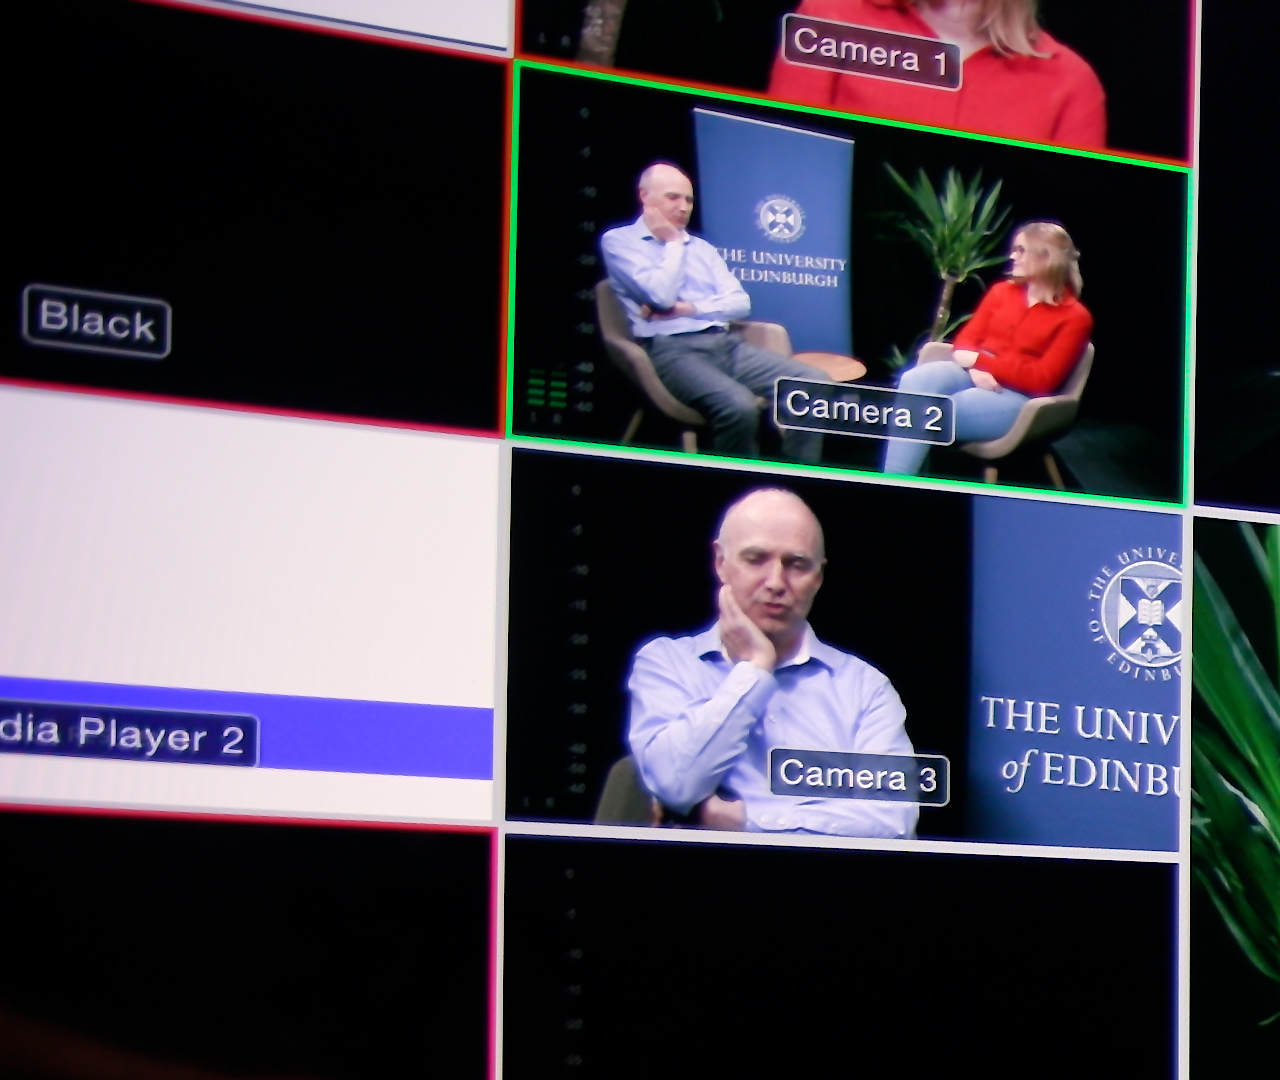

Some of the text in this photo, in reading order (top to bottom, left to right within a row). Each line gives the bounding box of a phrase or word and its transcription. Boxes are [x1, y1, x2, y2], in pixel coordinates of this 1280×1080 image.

[794, 27, 946, 76] Camera 1
[740, 268, 838, 288] EDINBURGH
[752, 250, 847, 271] UNIVERSITY
[41, 298, 156, 343] Black
[786, 389, 943, 431] Camera 2
[1088, 565, 1113, 600] THE
[1117, 546, 1182, 568] UNIVE
[79, 716, 209, 757] Player
[222, 725, 244, 755] 2
[980, 695, 1181, 746] THE UNIV
[780, 758, 937, 793] Camera 3
[1002, 748, 1039, 793] of
